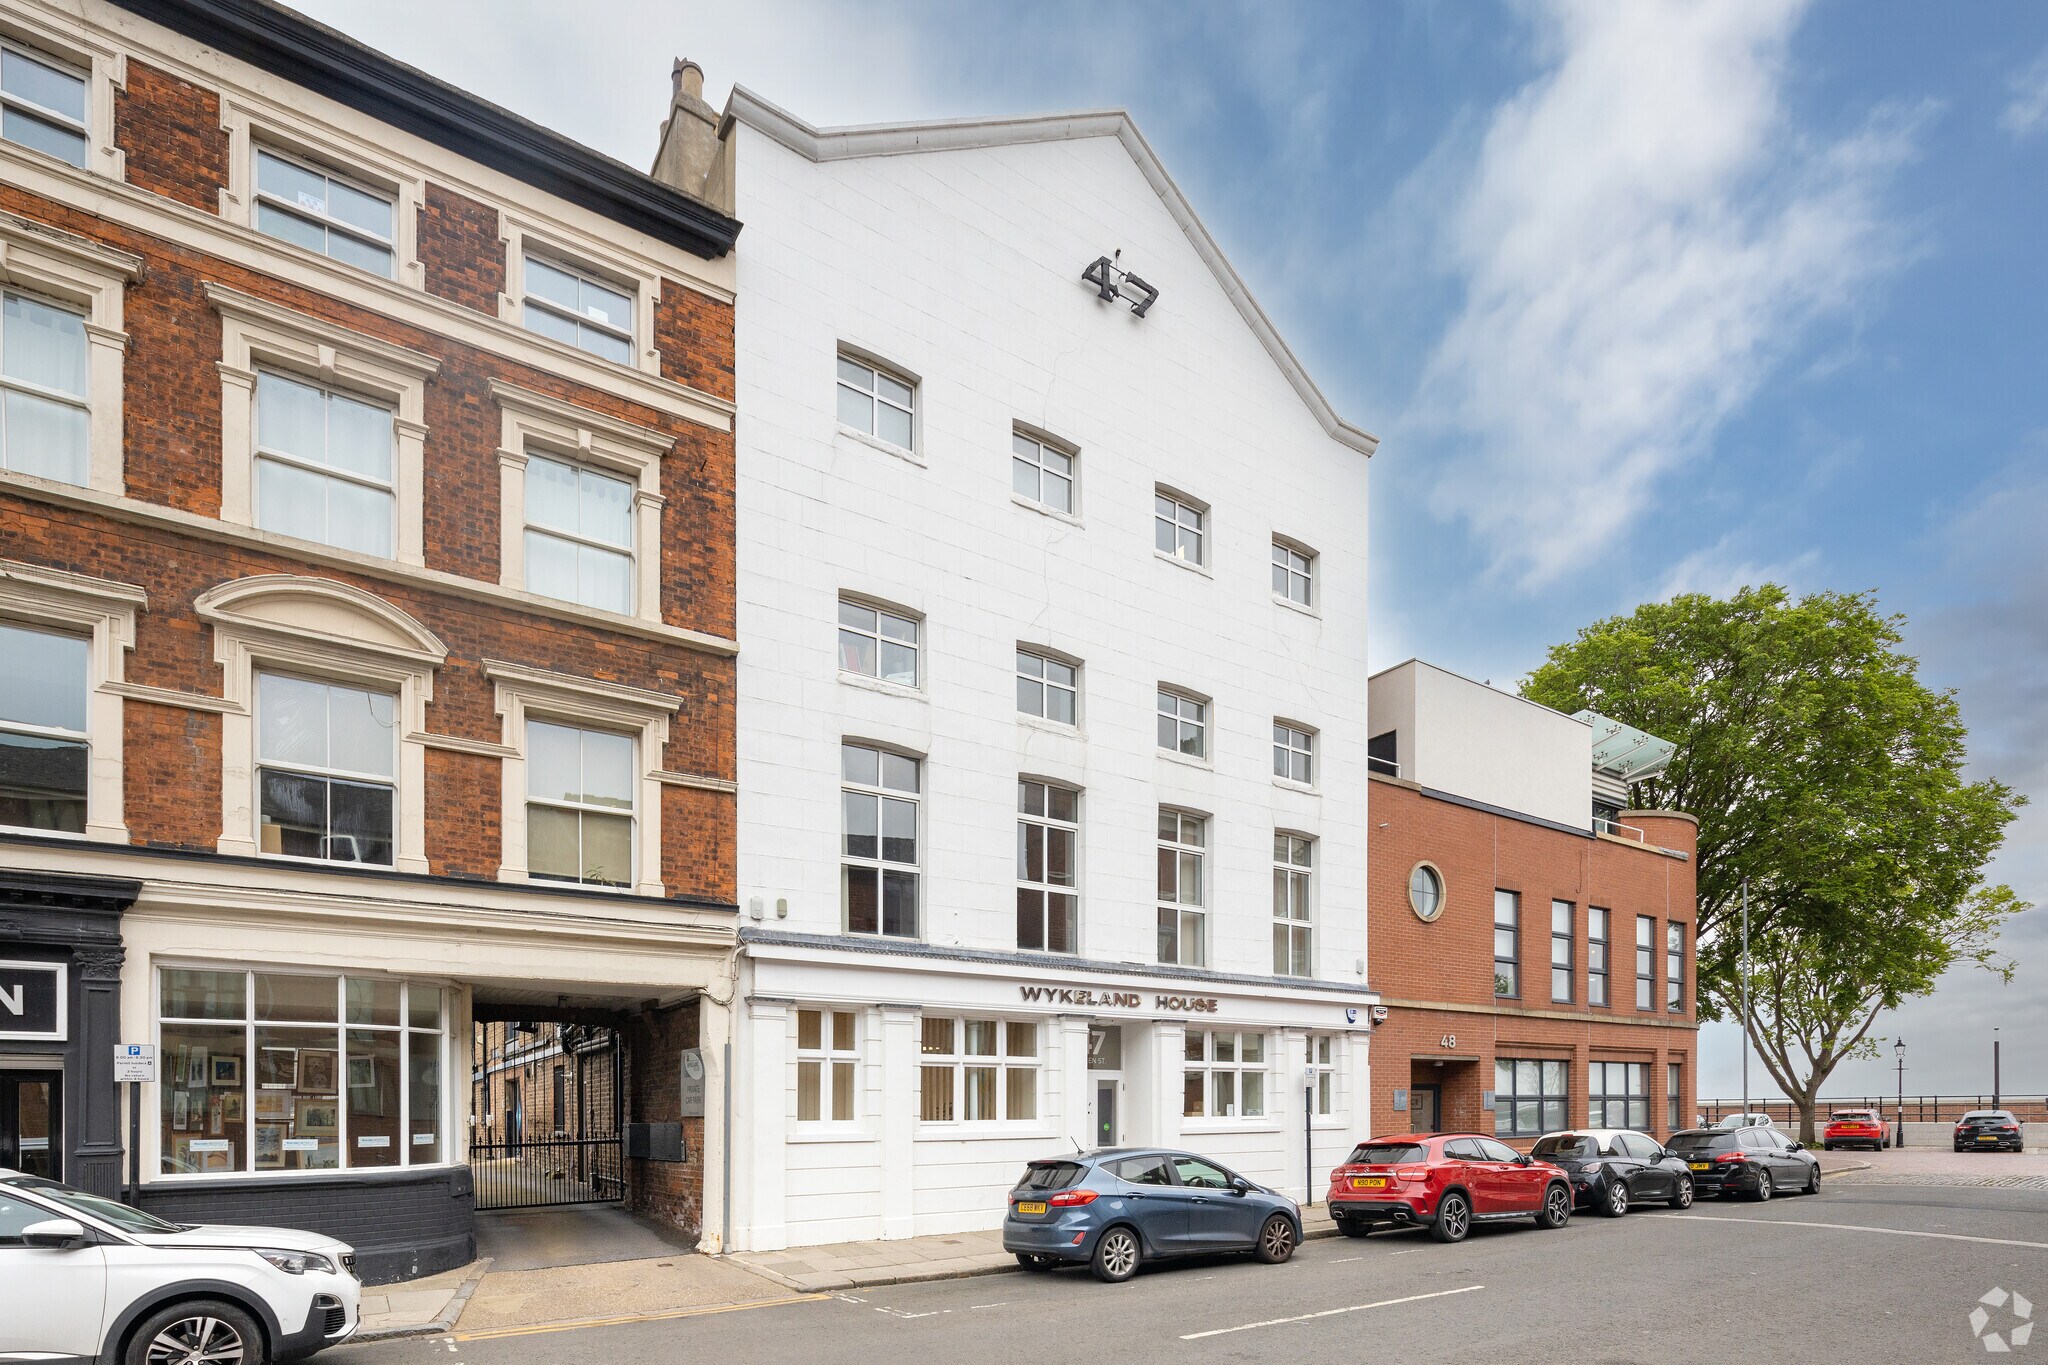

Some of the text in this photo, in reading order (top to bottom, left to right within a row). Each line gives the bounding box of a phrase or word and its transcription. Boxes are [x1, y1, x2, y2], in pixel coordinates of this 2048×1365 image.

[1081, 255, 1160, 319] 47
[1019, 986, 1218, 1013] WYKELAND HOUSE
[1089, 1030, 1106, 1055] 7
[1440, 1034, 1456, 1049] 48
